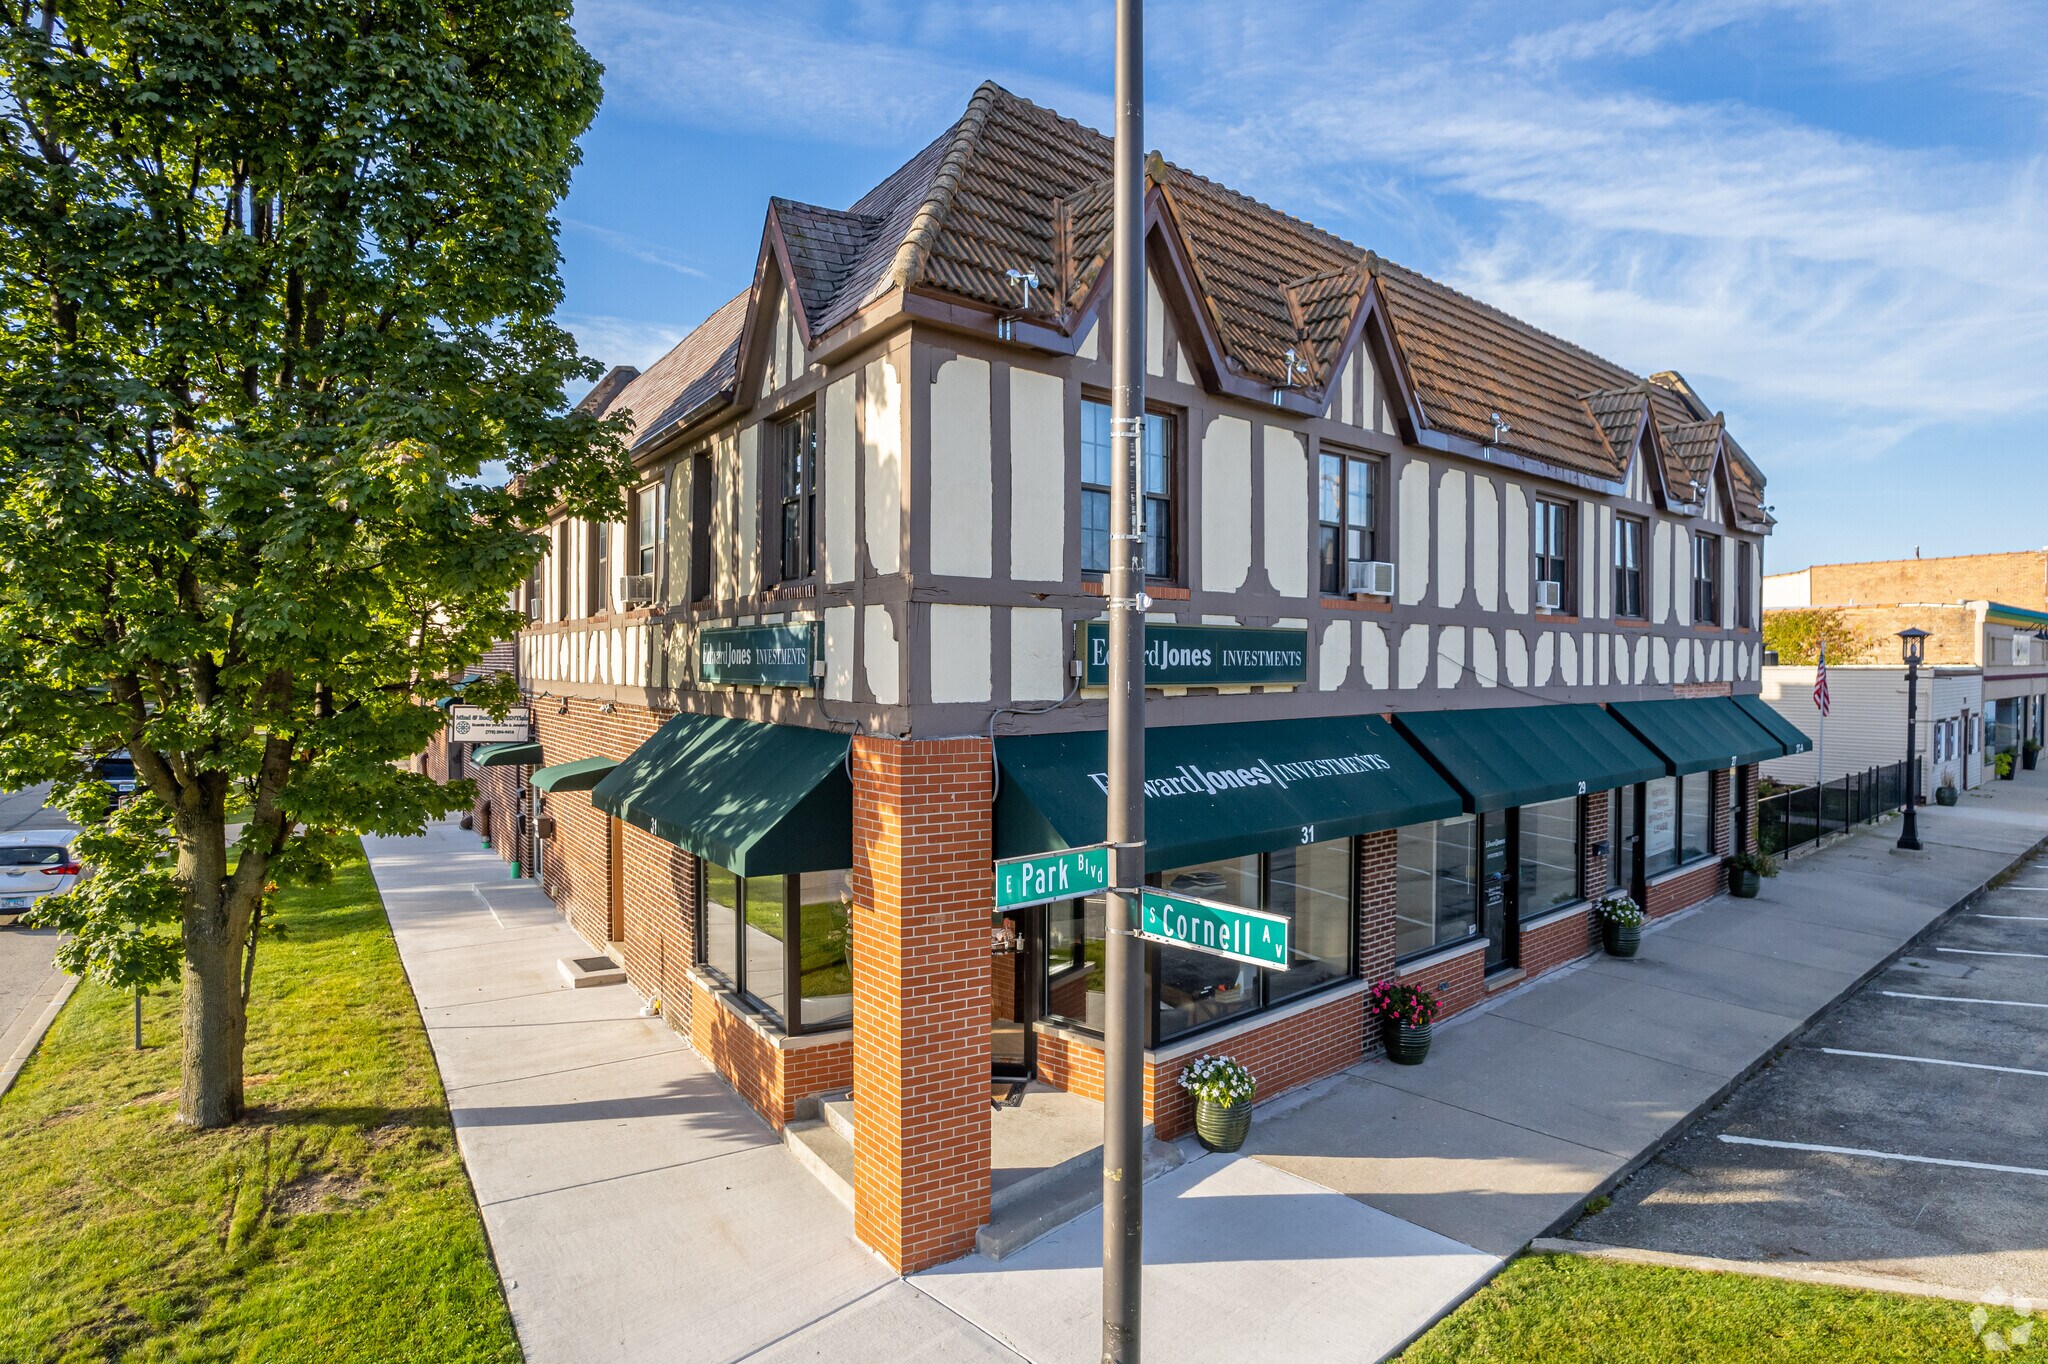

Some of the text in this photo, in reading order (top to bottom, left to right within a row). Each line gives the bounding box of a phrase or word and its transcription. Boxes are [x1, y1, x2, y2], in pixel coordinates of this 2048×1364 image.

[756, 647, 806, 665] INVESTMENTS
[1222, 649, 1302, 667] INVESTMENTS
[1273, 753, 1391, 782] INVESTMENTS
[1578, 780, 1586, 795] 29
[1652, 799, 1669, 809] OFFICE
[650, 817, 657, 835] 31
[1648, 811, 1663, 824] SPACE
[1301, 825, 1314, 845] 31
[1653, 821, 1669, 834] LEASE
[1006, 854, 1103, 897] E Park Blvd
[1149, 906, 1156, 924] S
[1162, 904, 1250, 955] Cornell
